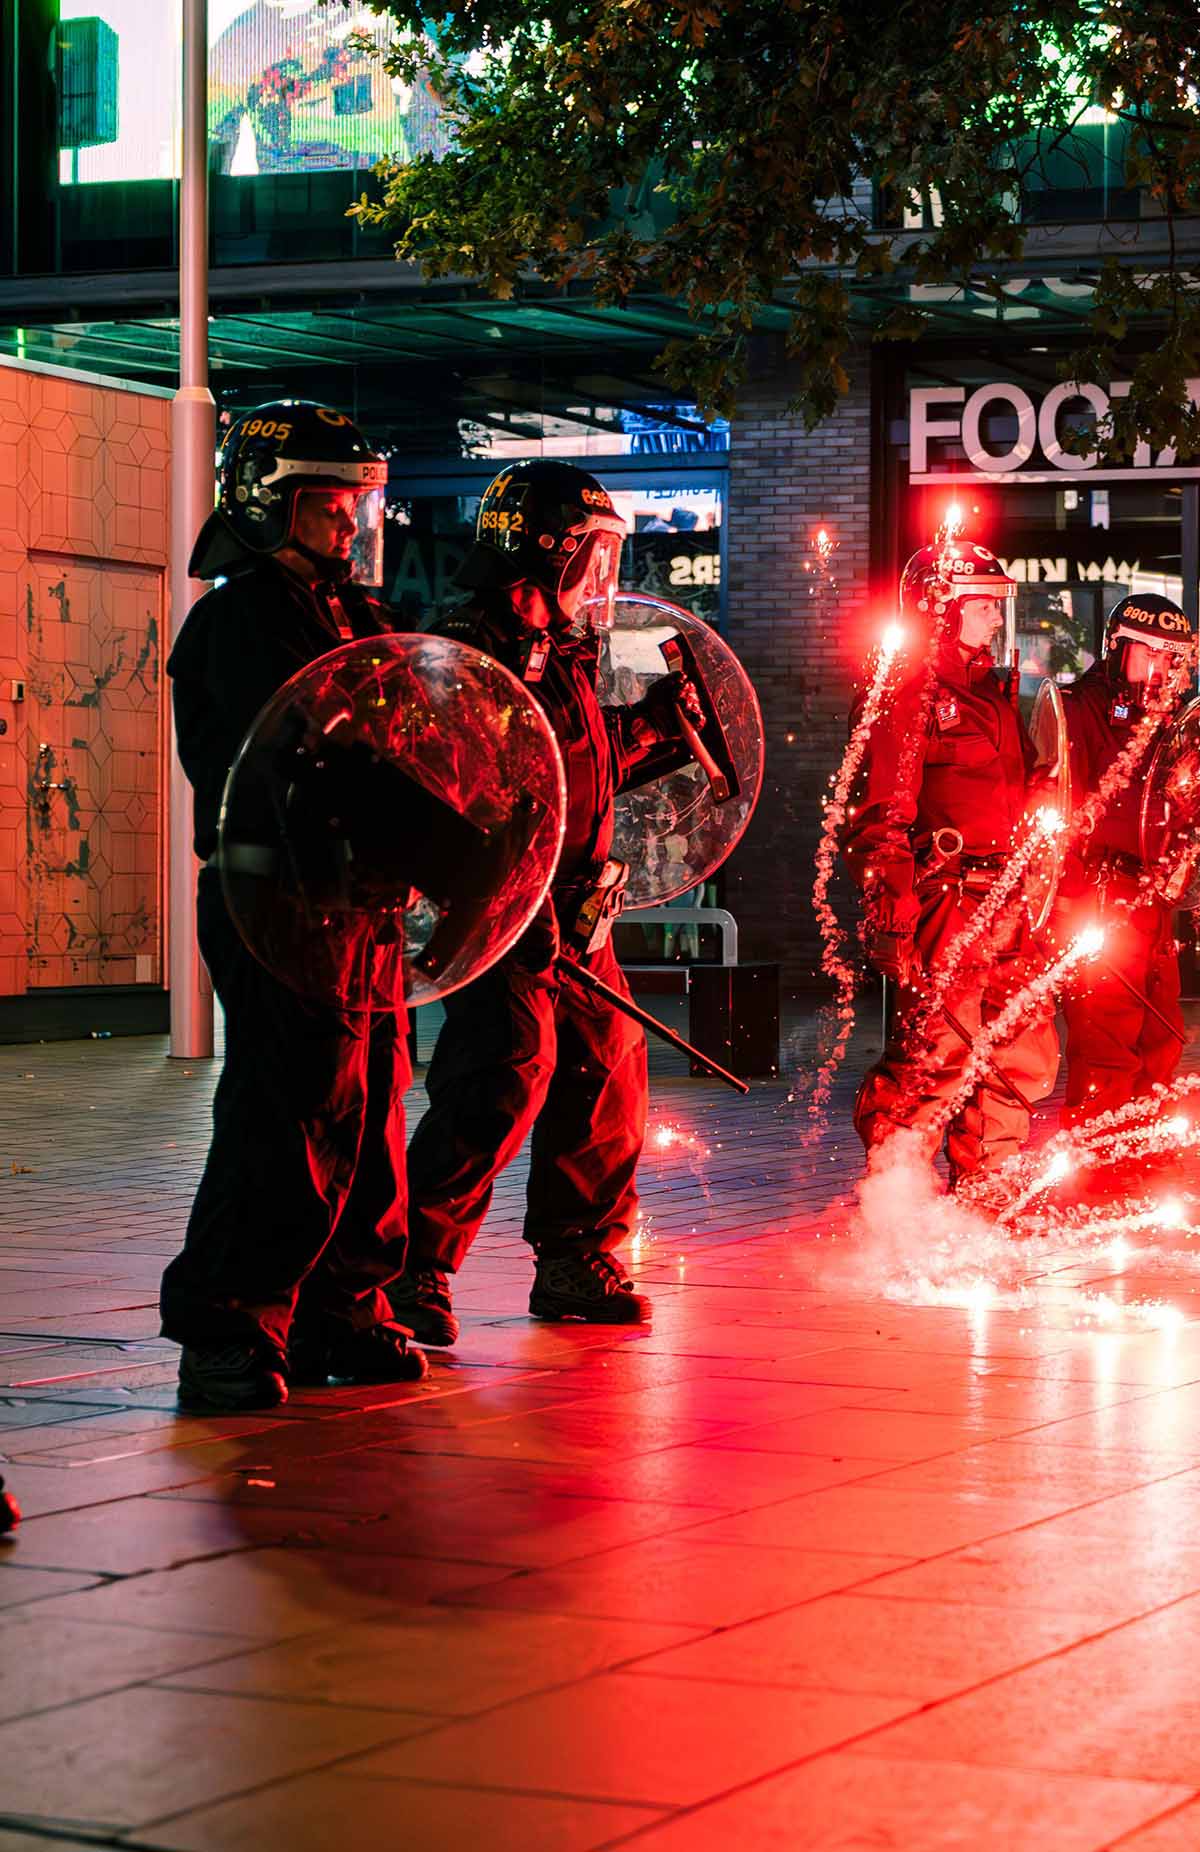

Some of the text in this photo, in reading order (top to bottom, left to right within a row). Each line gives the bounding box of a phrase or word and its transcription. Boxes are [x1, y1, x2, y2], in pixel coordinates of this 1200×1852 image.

[240, 419, 293, 441] 1905
[482, 511, 524, 532] 6352
[937, 558, 975, 575] 1486
[1123, 606, 1155, 625] 8901
